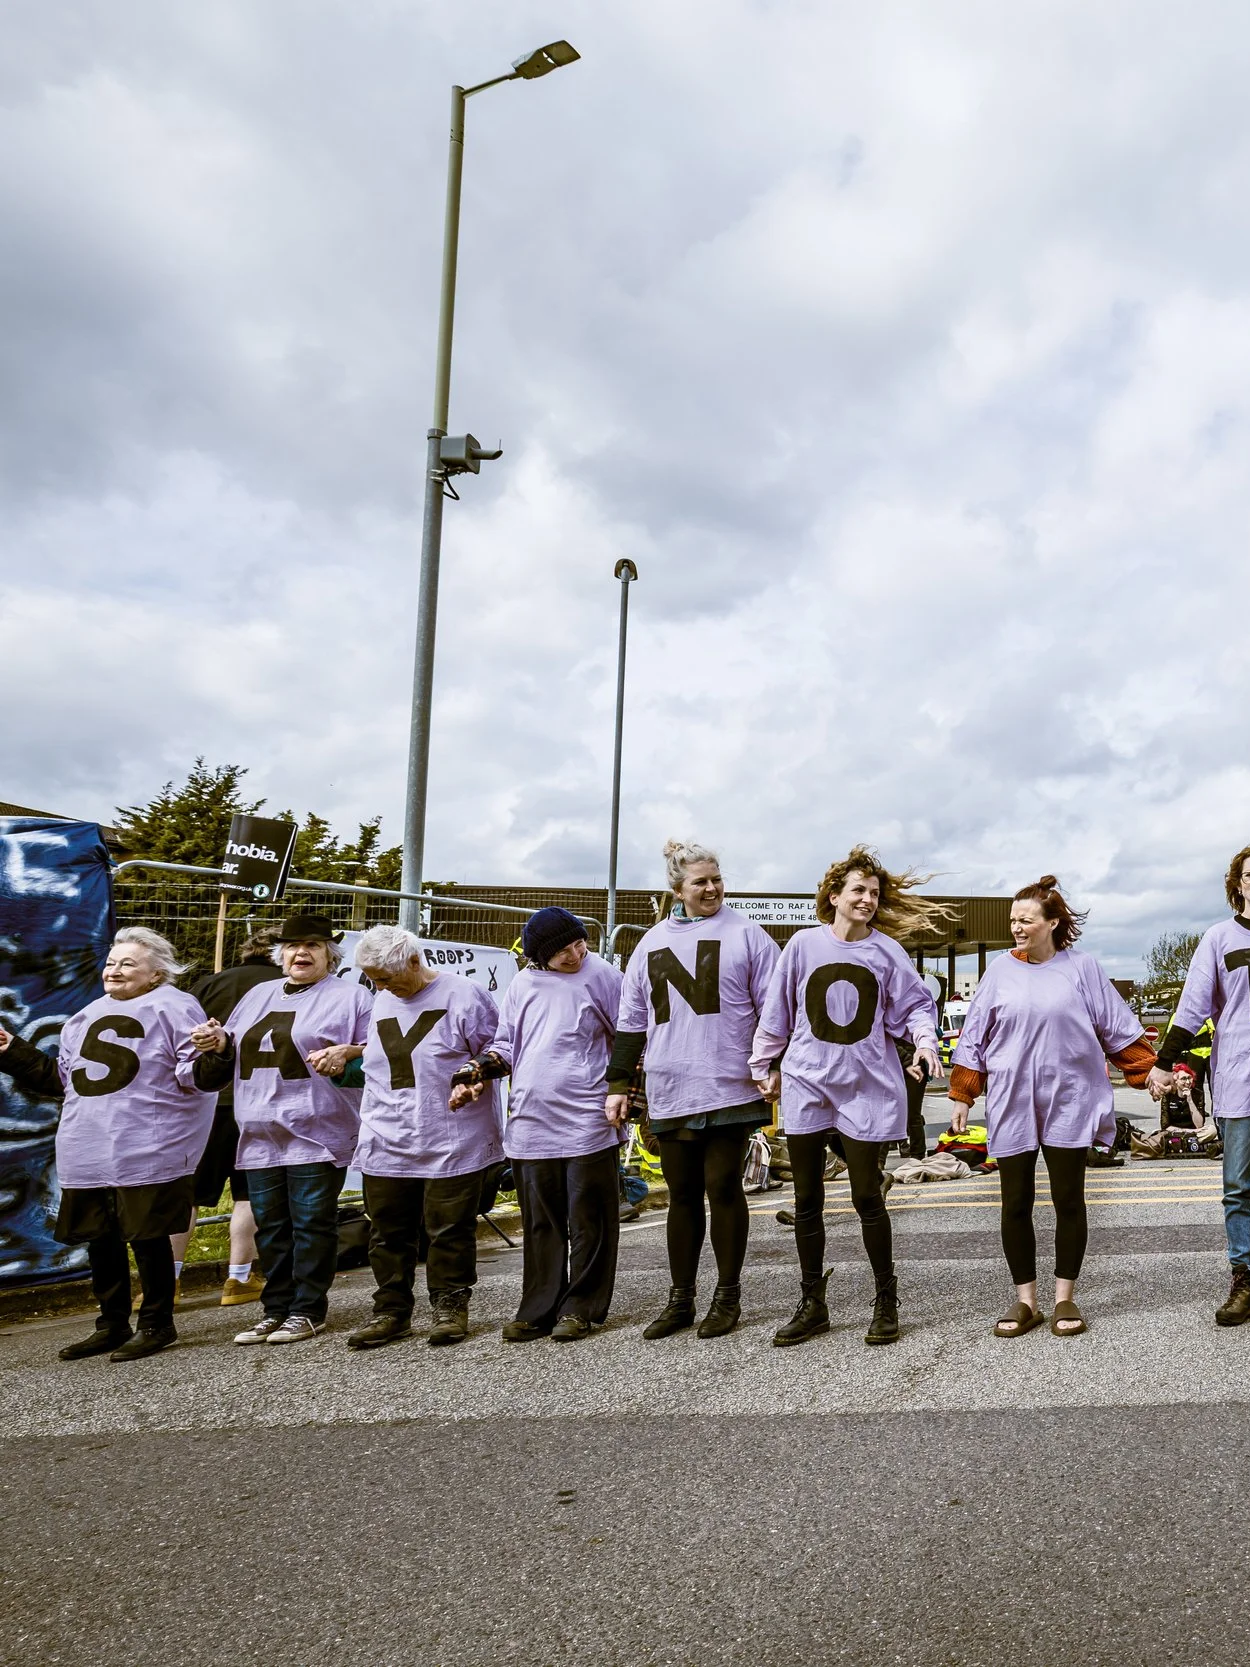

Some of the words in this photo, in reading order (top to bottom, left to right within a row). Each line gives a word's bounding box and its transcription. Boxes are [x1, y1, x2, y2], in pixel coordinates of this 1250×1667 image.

[225, 840, 279, 863] hobia.
[647, 940, 720, 1025] N
[805, 962, 880, 1045] O
[71, 1014, 145, 1097] S
[240, 1011, 311, 1080] A
[377, 1009, 448, 1091] Y
